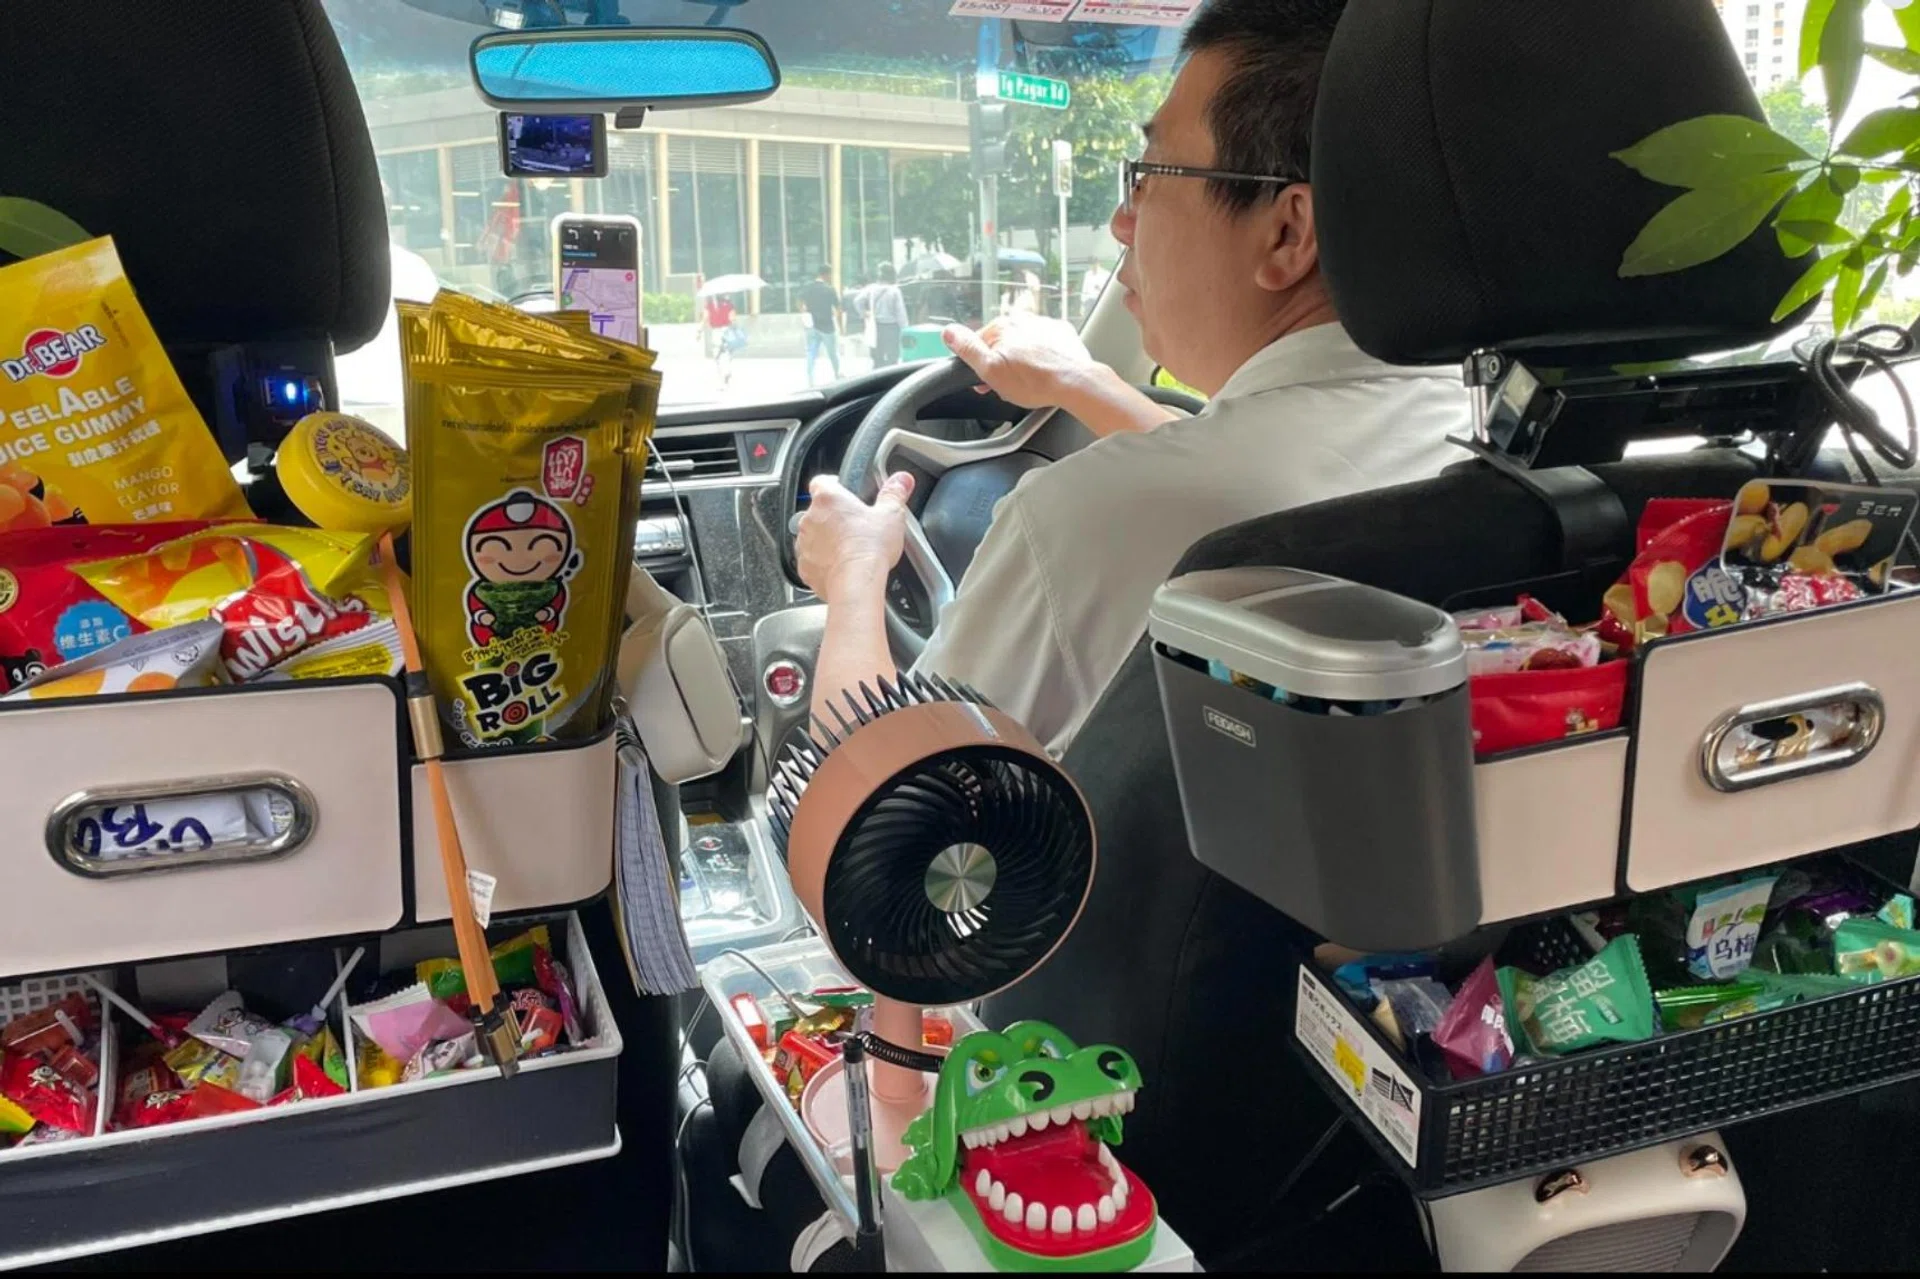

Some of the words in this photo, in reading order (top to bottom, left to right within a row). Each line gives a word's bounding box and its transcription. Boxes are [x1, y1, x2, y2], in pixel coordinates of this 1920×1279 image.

[1050, 82, 1065, 101] Rd
[54, 396, 146, 444] GUMMY
[113, 465, 173, 490] MANGO
[117, 482, 180, 508] FLAVOR
[59, 624, 126, 650] 维生素C
[475, 686, 561, 732] ROLL
